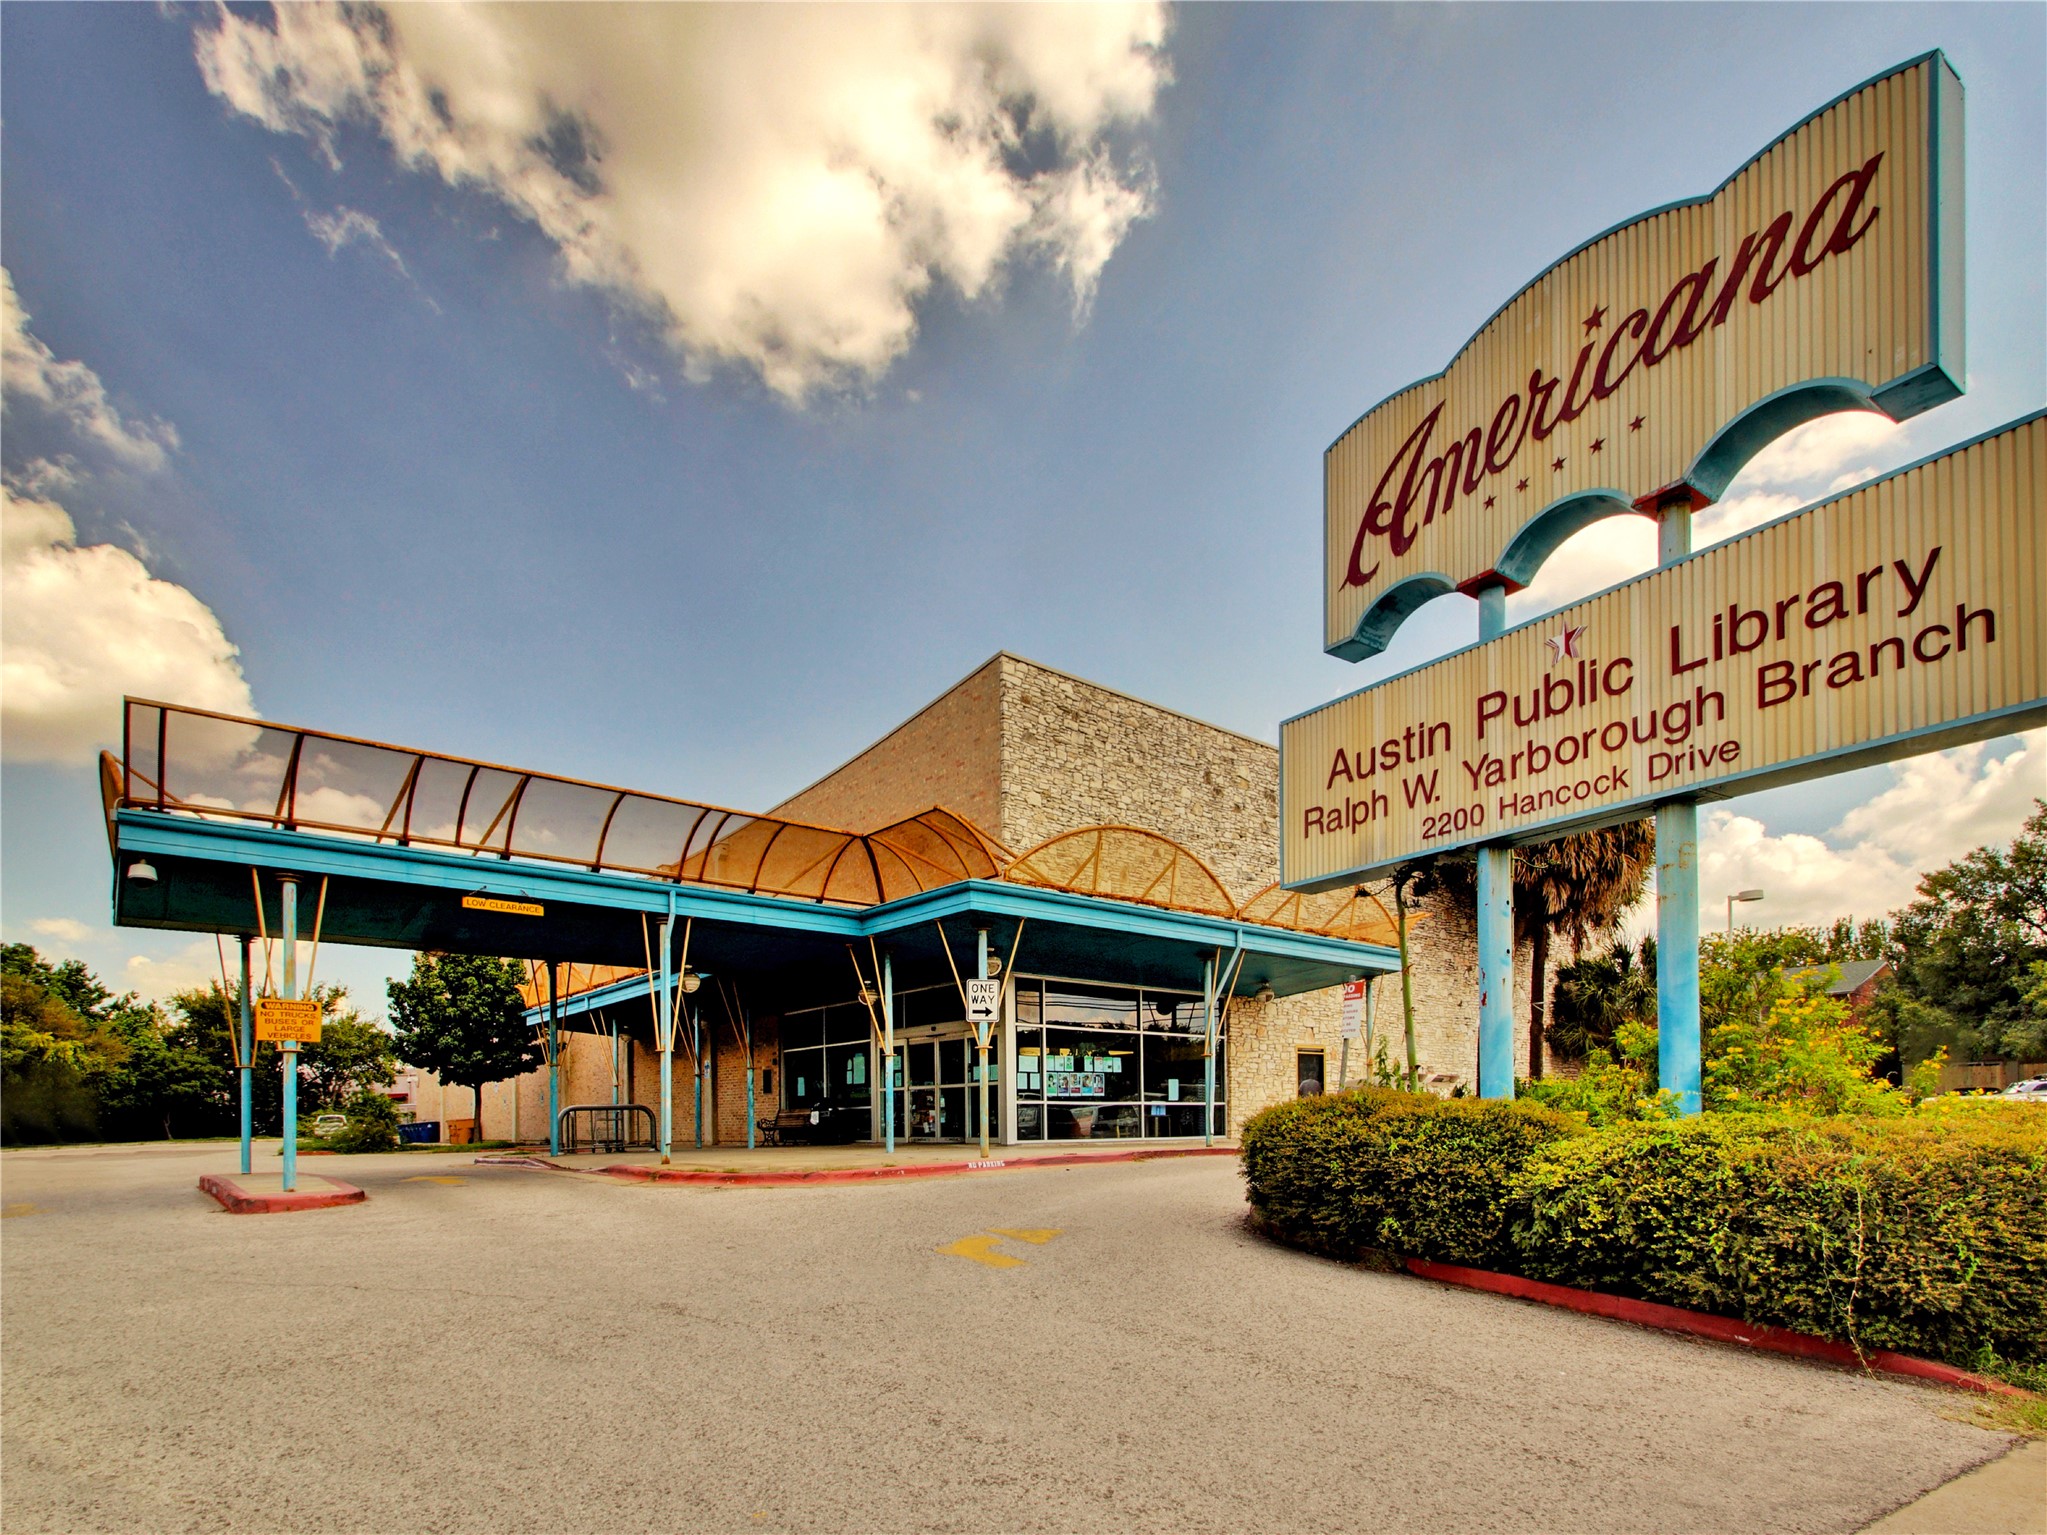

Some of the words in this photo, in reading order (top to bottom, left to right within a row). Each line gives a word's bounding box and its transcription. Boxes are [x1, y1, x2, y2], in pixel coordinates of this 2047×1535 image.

[1339, 151, 1885, 591] Americana
[1326, 720, 1451, 790] Austin
[1477, 656, 1634, 740] Public
[1671, 546, 1942, 676] Library
[1304, 789, 1388, 838] Ralph
[1402, 768, 1440, 809] W.
[1462, 686, 1725, 791] Yarborough
[1758, 603, 1995, 709] Branch
[1422, 803, 1485, 840] 2200
[1499, 766, 1629, 820] Hancock
[1649, 740, 1740, 781] Drive
[466, 898, 486, 907] LOW
[489, 901, 540, 913] CLEARANCE
[971, 983, 995, 994] ONE
[971, 995, 995, 1005] WAY
[264, 1002, 314, 1011] WARNING
[274, 1025, 305, 1033] LARGE
[267, 1032, 312, 1040] VEHICLES
[978, 1160, 1005, 1168] PARKING
